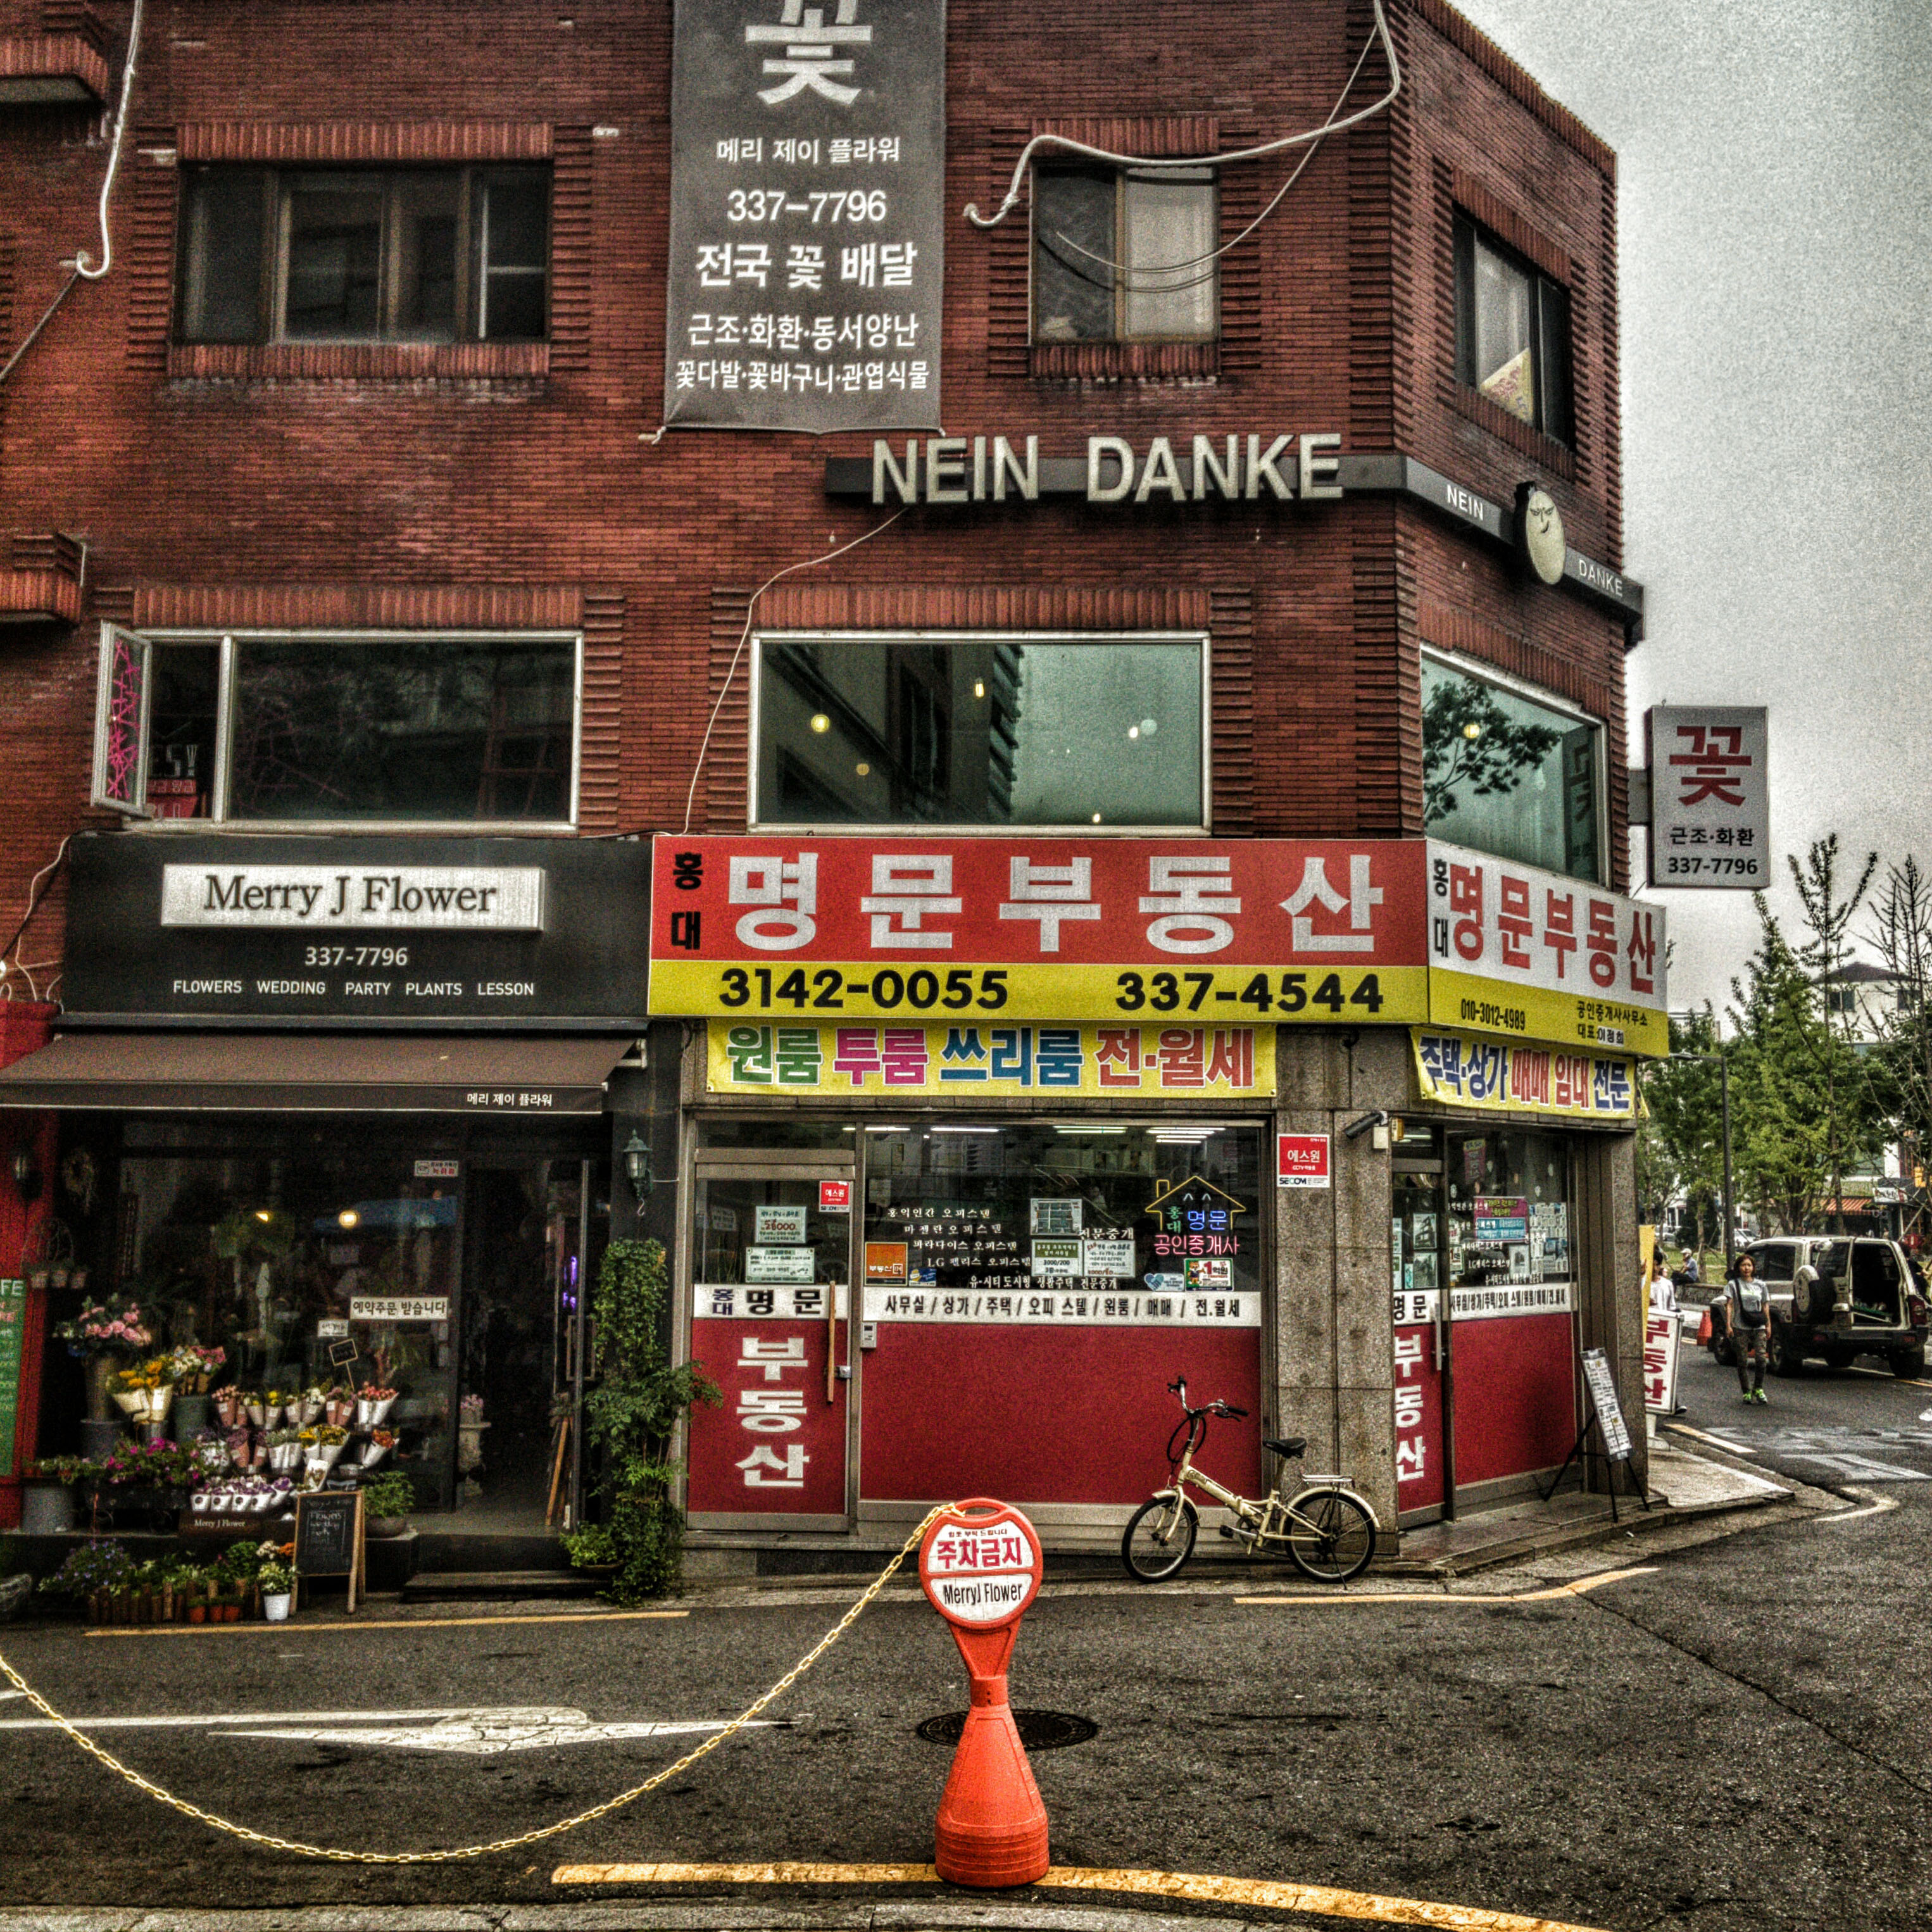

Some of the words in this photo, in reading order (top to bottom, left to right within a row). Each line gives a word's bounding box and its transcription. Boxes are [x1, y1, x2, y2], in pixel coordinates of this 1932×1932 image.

[716, 138, 762, 163] 메리
[772, 138, 819, 164] 제이
[829, 137, 900, 163] 플라워
[727, 191, 887, 222] 337-7796
[696, 243, 771, 287] 전국
[786, 246, 824, 289] 꽃
[840, 242, 918, 287] 배달
[872, 436, 1039, 504] NEIN
[1087, 433, 1343, 503] DANKE
[1446, 484, 1484, 521] NEIN
[1579, 560, 1623, 597] DANKE
[1669, 725, 1752, 806] 꽃
[1668, 857, 1759, 875] 337-7796
[203, 874, 323, 917] Merry
[330, 876, 351, 916] J
[361, 877, 498, 912] Flower
[304, 946, 408, 967] 337-7796
[173, 979, 242, 994] FLOWERS
[257, 981, 326, 995] WEDDING
[346, 982, 391, 996] PARTY
[405, 982, 463, 996] PLANTS
[477, 982, 534, 996] LESSON
[718, 968, 1008, 1009] 3142-0055
[1115, 972, 1384, 1013] 337-4544
[1460, 998, 1526, 1031] 010-3012-4989
[727, 1025, 823, 1086] 원룸
[834, 1027, 929, 1086] 투룸
[940, 1027, 1084, 1088] 쓰리룸
[1510, 1048, 1550, 1106] 매매
[1555, 1053, 1590, 1110] 임대
[1593, 1059, 1630, 1112] 전문
[467, 1093, 489, 1105] 메리
[492, 1093, 515, 1106] 제이
[519, 1094, 553, 1107] 플라워
[1288, 1150, 1320, 1164] 에스원
[1166, 1206, 1184, 1234] 홍대
[1188, 1210, 1227, 1231] 명문
[1153, 1235, 1241, 1255] 공인중개사
[927, 1257, 944, 1267] LG
[353, 1301, 397, 1315] 예약주문
[401, 1301, 446, 1315] 받습니다
[712, 1289, 734, 1315] 홍대
[746, 1289, 822, 1315] 명문
[886, 1295, 924, 1314] 사무실
[943, 1296, 969, 1315] 상가
[987, 1297, 1011, 1315] 주택
[735, 1337, 810, 1488] 부동산
[194, 1519, 216, 1528] Merry
[222, 1519, 246, 1527] Flower
[937, 1536, 1023, 1569] 주차금지
[984, 1583, 1023, 1603] Flower
